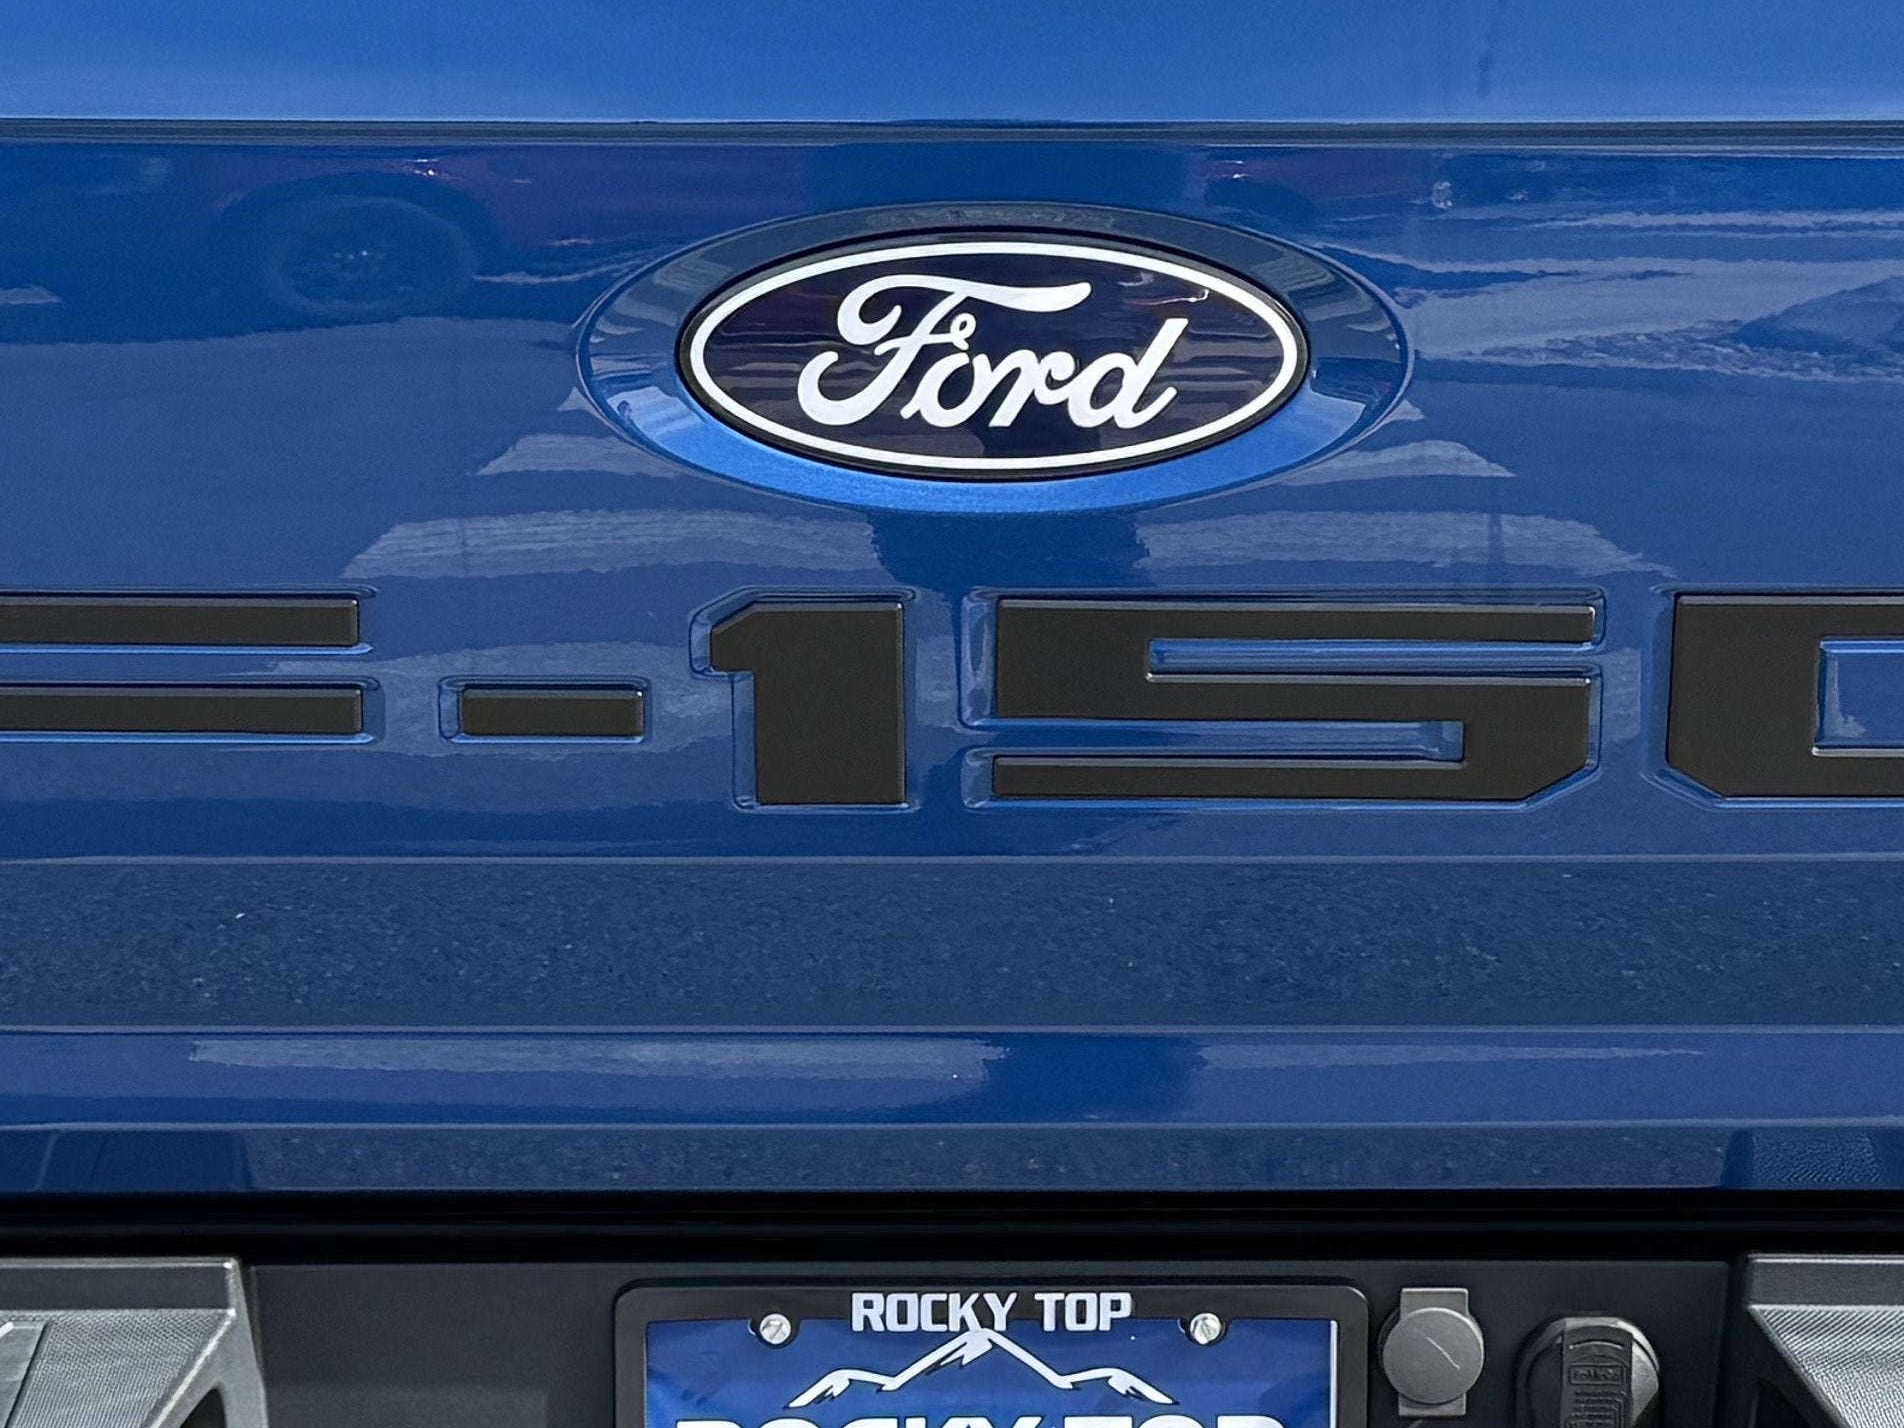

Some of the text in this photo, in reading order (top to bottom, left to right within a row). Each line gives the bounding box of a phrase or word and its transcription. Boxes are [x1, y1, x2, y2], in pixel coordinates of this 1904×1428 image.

[797, 274, 1188, 429] Ford
[851, 1292, 1132, 1332] ROCKY TOP
